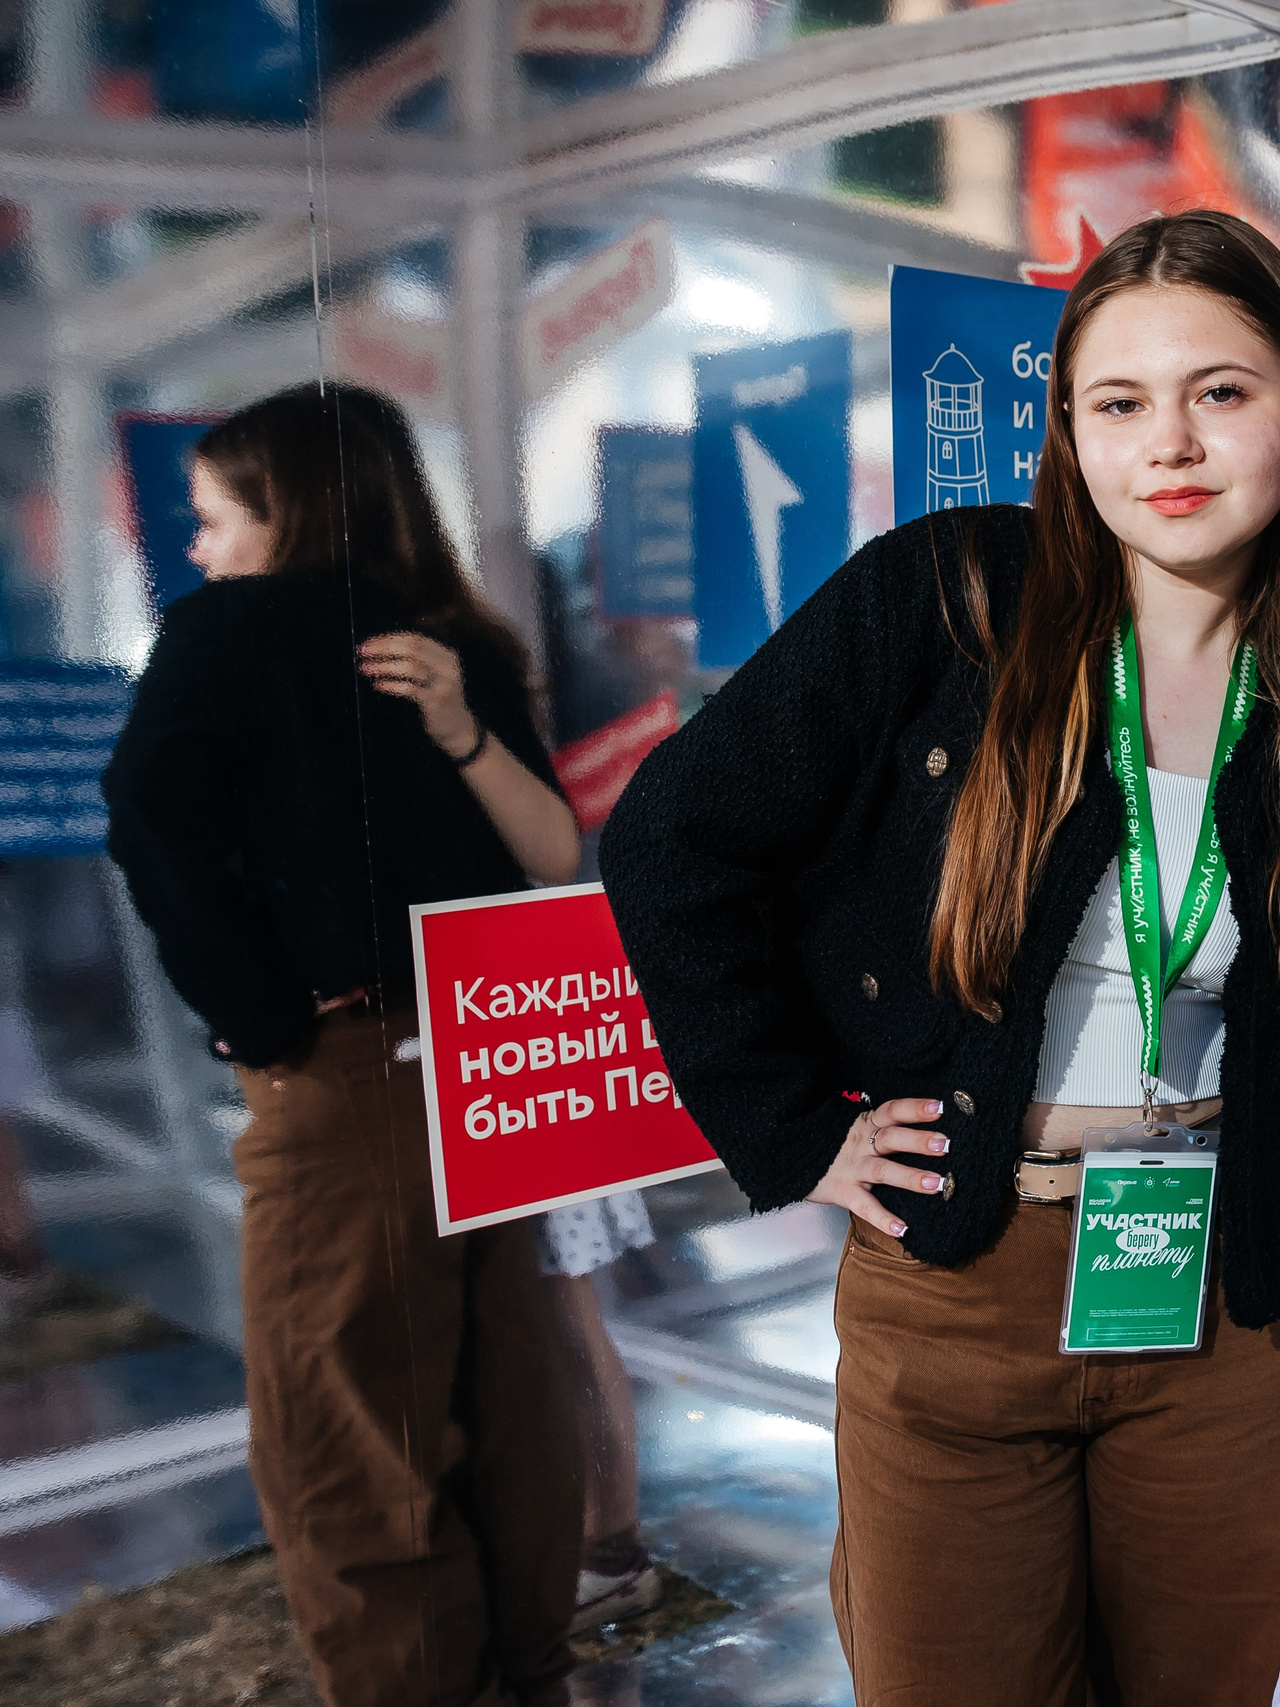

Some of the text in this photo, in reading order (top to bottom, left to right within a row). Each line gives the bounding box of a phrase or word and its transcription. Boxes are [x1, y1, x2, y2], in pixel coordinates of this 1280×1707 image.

[1013, 401, 1034, 430] и
[1119, 726, 1138, 816] волнуйтесь
[1128, 817, 1140, 840] не
[1208, 854, 1218, 864] я
[1181, 866, 1216, 945] участник
[1135, 934, 1147, 943] я
[459, 1010, 628, 1084] новый
[464, 1088, 595, 1140] быть
[1086, 1212, 1204, 1231] УЧАСТНИК
[1126, 1229, 1160, 1250] берегу
[1090, 1245, 1195, 1279] планету
